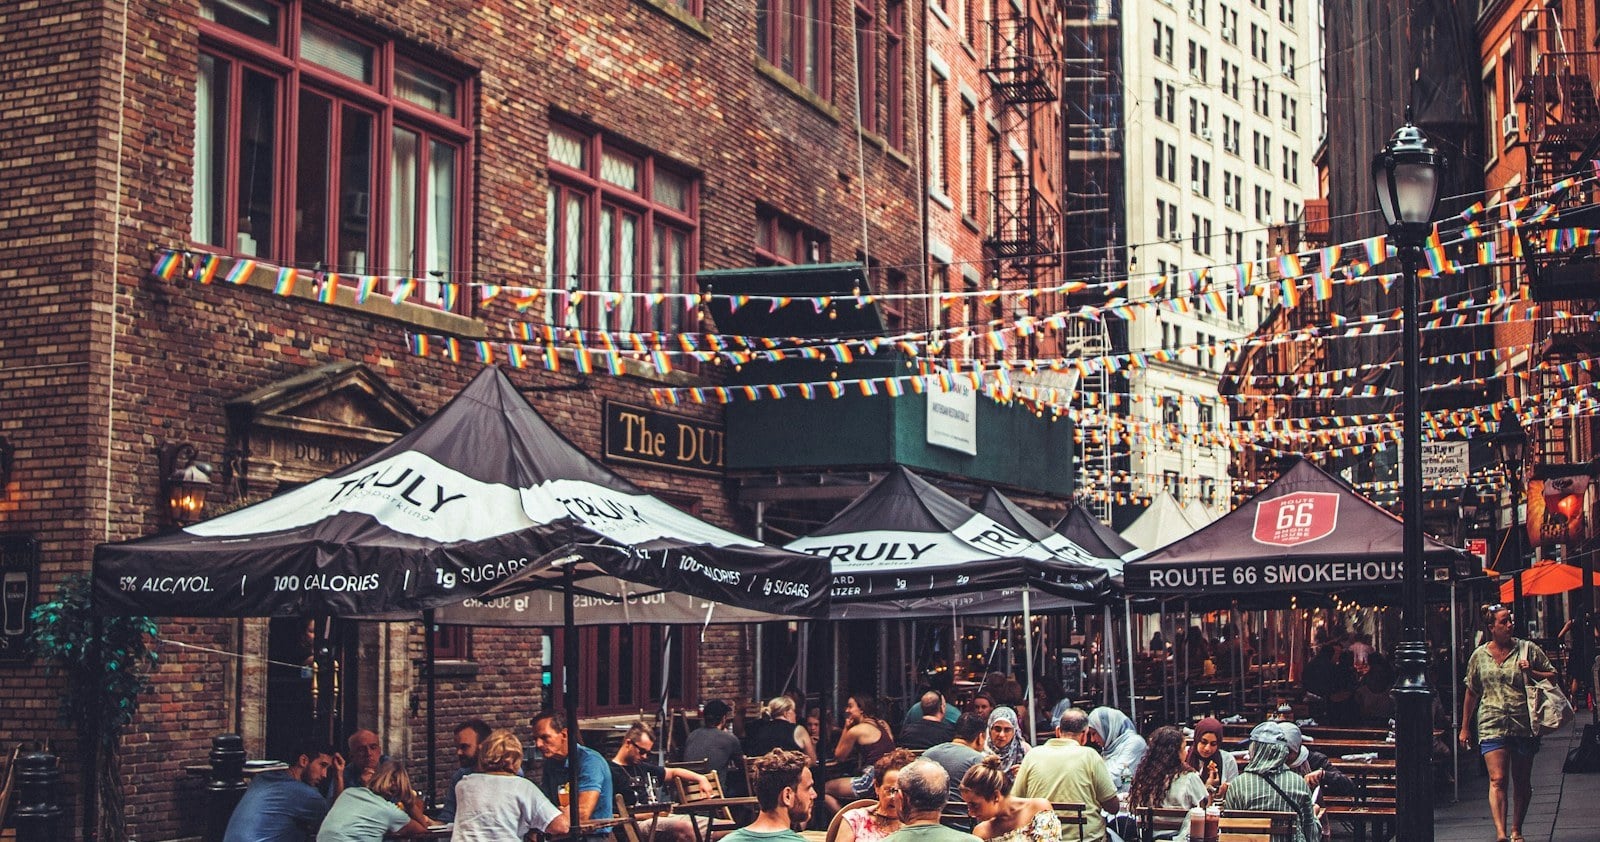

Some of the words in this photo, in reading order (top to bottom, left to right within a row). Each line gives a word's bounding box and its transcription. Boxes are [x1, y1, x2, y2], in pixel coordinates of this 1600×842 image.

[620, 412, 666, 456] The
[329, 465, 467, 513] TRULY
[1276, 503, 1314, 530] 66
[803, 543, 937, 562] TRULY
[120, 576, 137, 591] 5%
[273, 576, 299, 592] 100
[304, 573, 379, 591] CALORIES
[436, 568, 456, 589] 1g
[833, 576, 854, 585] ARD
[896, 578, 907, 588] 1g
[1149, 567, 1226, 587] ROUTE
[1232, 566, 1257, 585] 66
[1263, 561, 1427, 584] SMOKEHOU
[763, 578, 774, 596] 1g
[774, 580, 809, 598] SUGARS
[831, 587, 861, 596] LTZER
